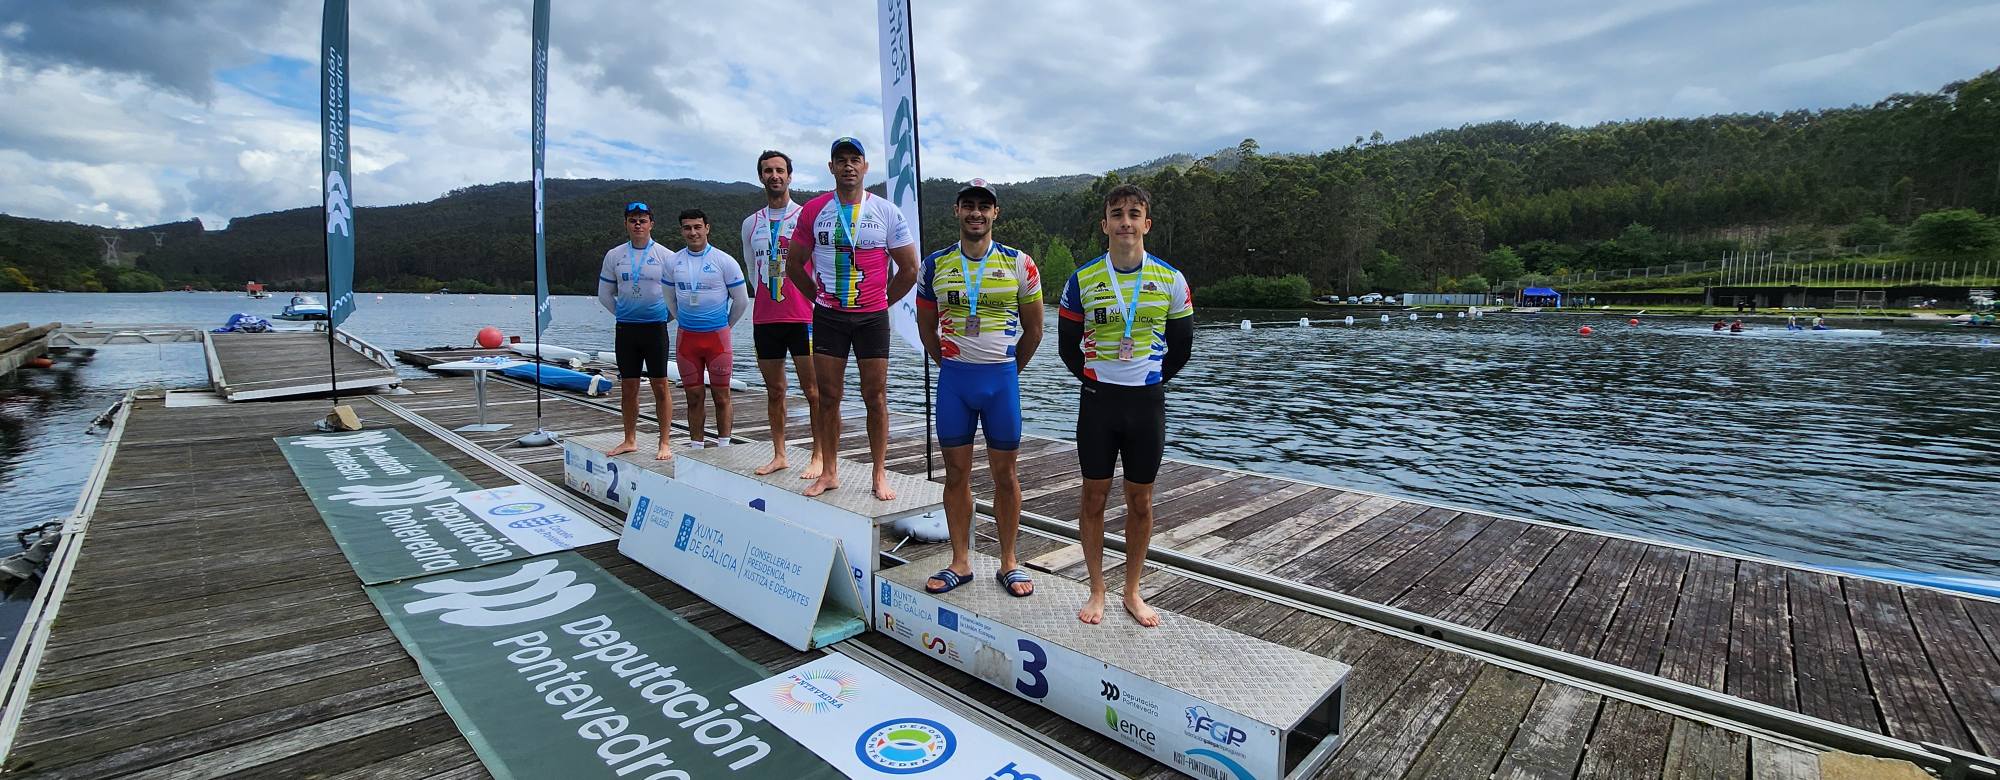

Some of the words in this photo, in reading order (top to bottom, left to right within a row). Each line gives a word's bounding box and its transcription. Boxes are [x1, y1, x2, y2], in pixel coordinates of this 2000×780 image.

[328, 46, 339, 159] Deputación
[607, 462, 620, 503] 2
[650, 514, 670, 529] GALEGO
[652, 505, 675, 521] DEPORTE
[376, 507, 460, 572] Pontevedra
[423, 501, 516, 561] Deputación
[694, 522, 725, 548] XUNTA
[689, 538, 702, 555] DE
[702, 544, 739, 573] GALICIA
[747, 557, 787, 584] PRESIDENCIA,
[791, 565, 802, 576] DE
[743, 569, 769, 588] XUSTIZA
[768, 580, 774, 591] E
[774, 584, 810, 608] DEPORTES
[893, 589, 918, 606] XUNTA
[893, 599, 904, 609] DE
[903, 604, 933, 623] GALICIA
[1015, 639, 1049, 699] 3
[560, 614, 771, 771] Deputación
[1122, 690, 1159, 711] Deputación
[1122, 697, 1159, 718] Pontevedra
[899, 724, 944, 750] DEPORTE
[1120, 719, 1156, 746] ence
[1194, 716, 1247, 748] FGP
[868, 731, 929, 767] PONTEVEDRA
